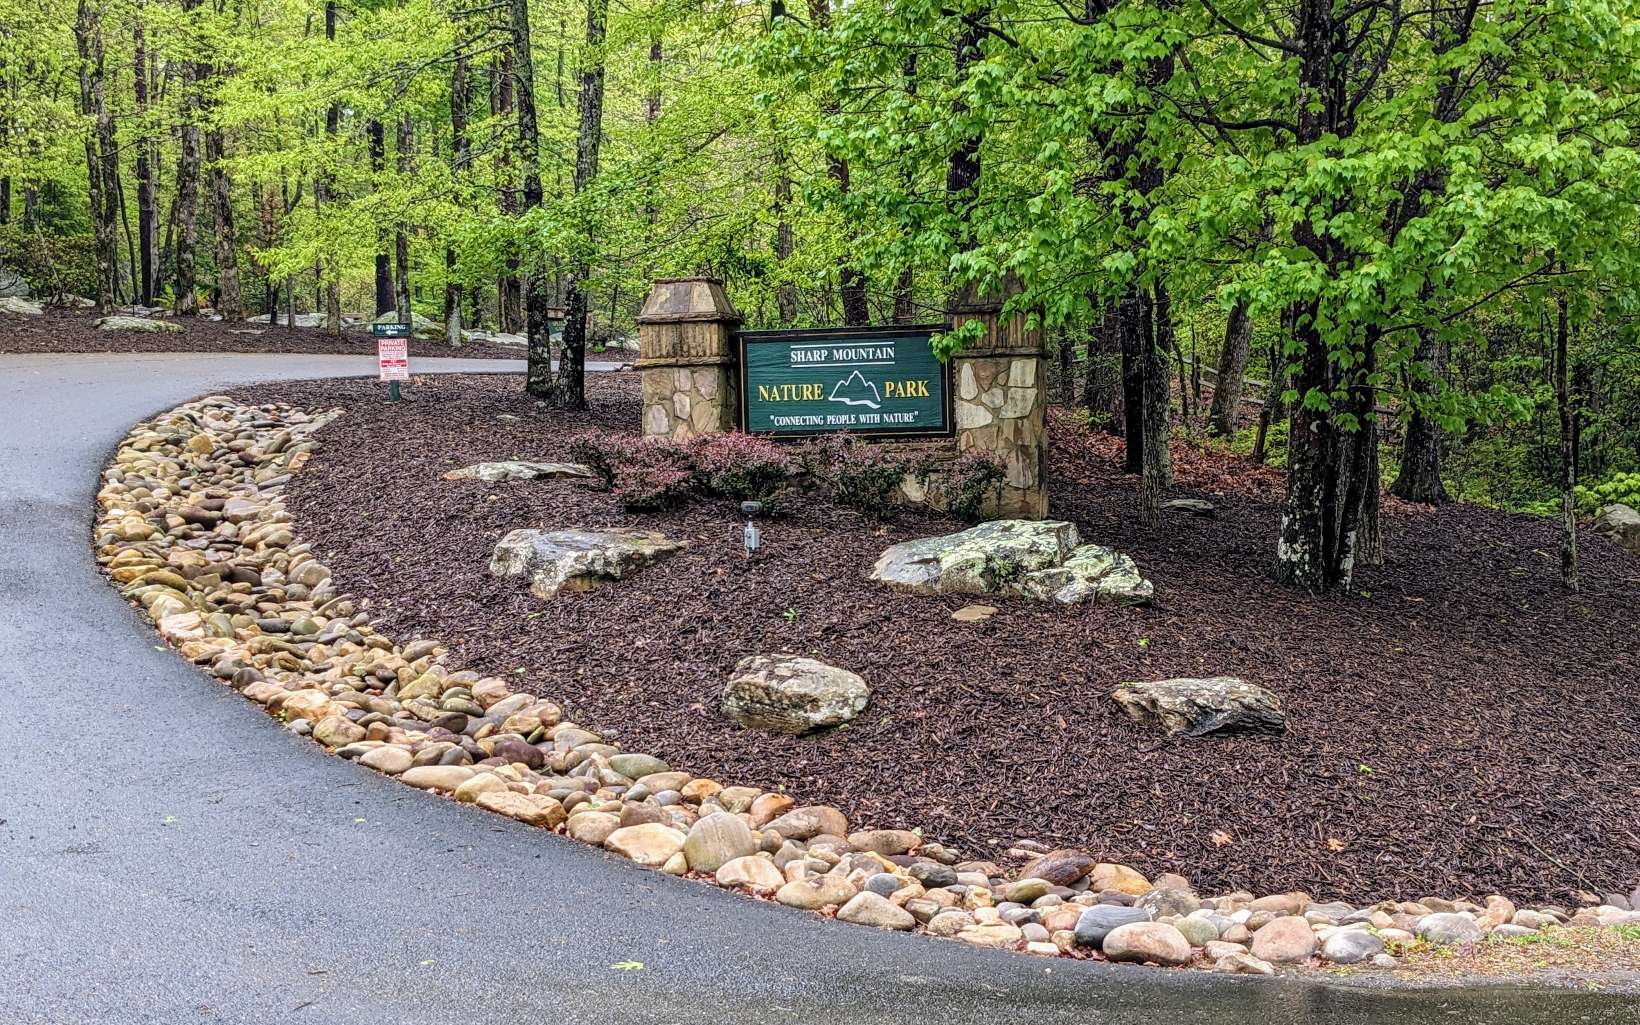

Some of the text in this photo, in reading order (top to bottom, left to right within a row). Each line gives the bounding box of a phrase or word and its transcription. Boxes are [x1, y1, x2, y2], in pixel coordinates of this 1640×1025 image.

[790, 347, 895, 362] SHARP MOUNTAIN
[758, 380, 930, 401] NATURE PARK
[770, 411, 919, 426] "CONNECTING PEOPLE WITH NATURE"
